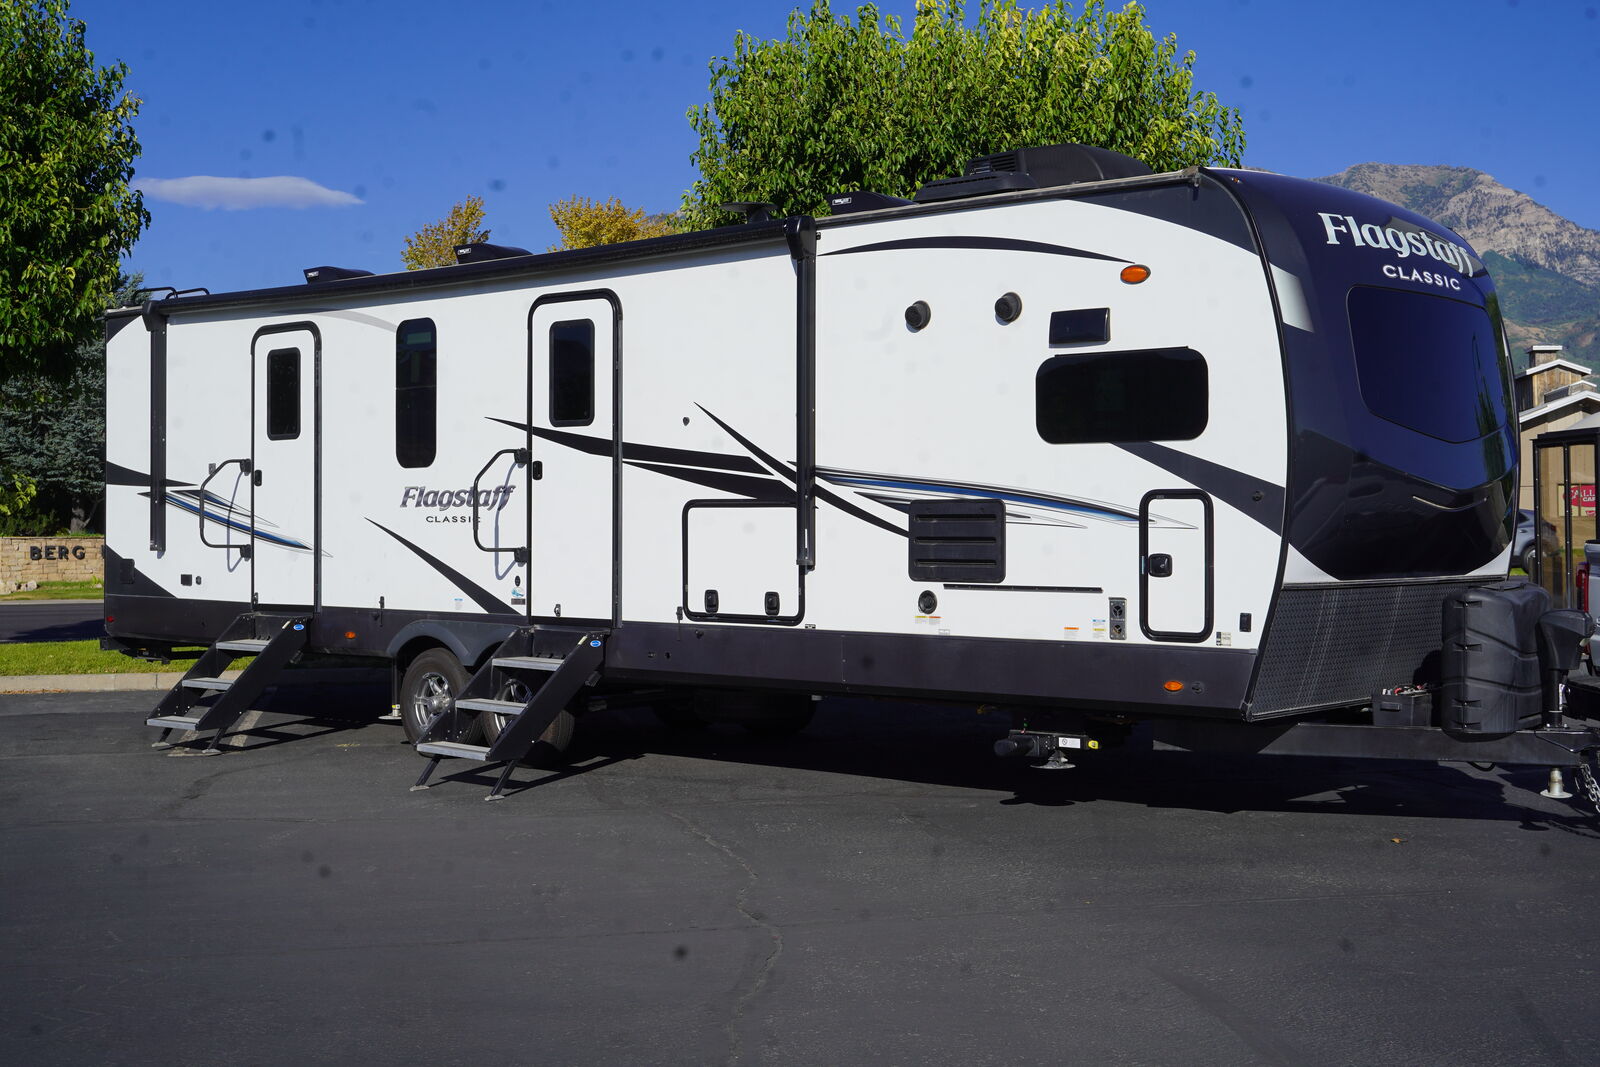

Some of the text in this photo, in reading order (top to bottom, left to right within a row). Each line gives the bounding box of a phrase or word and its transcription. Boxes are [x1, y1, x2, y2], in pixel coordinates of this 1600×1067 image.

[1318, 212, 1474, 278] Flagstaff
[1382, 264, 1461, 291] CLASSIC
[400, 485, 516, 511] Flagstaff
[30, 545, 86, 560] BERG
